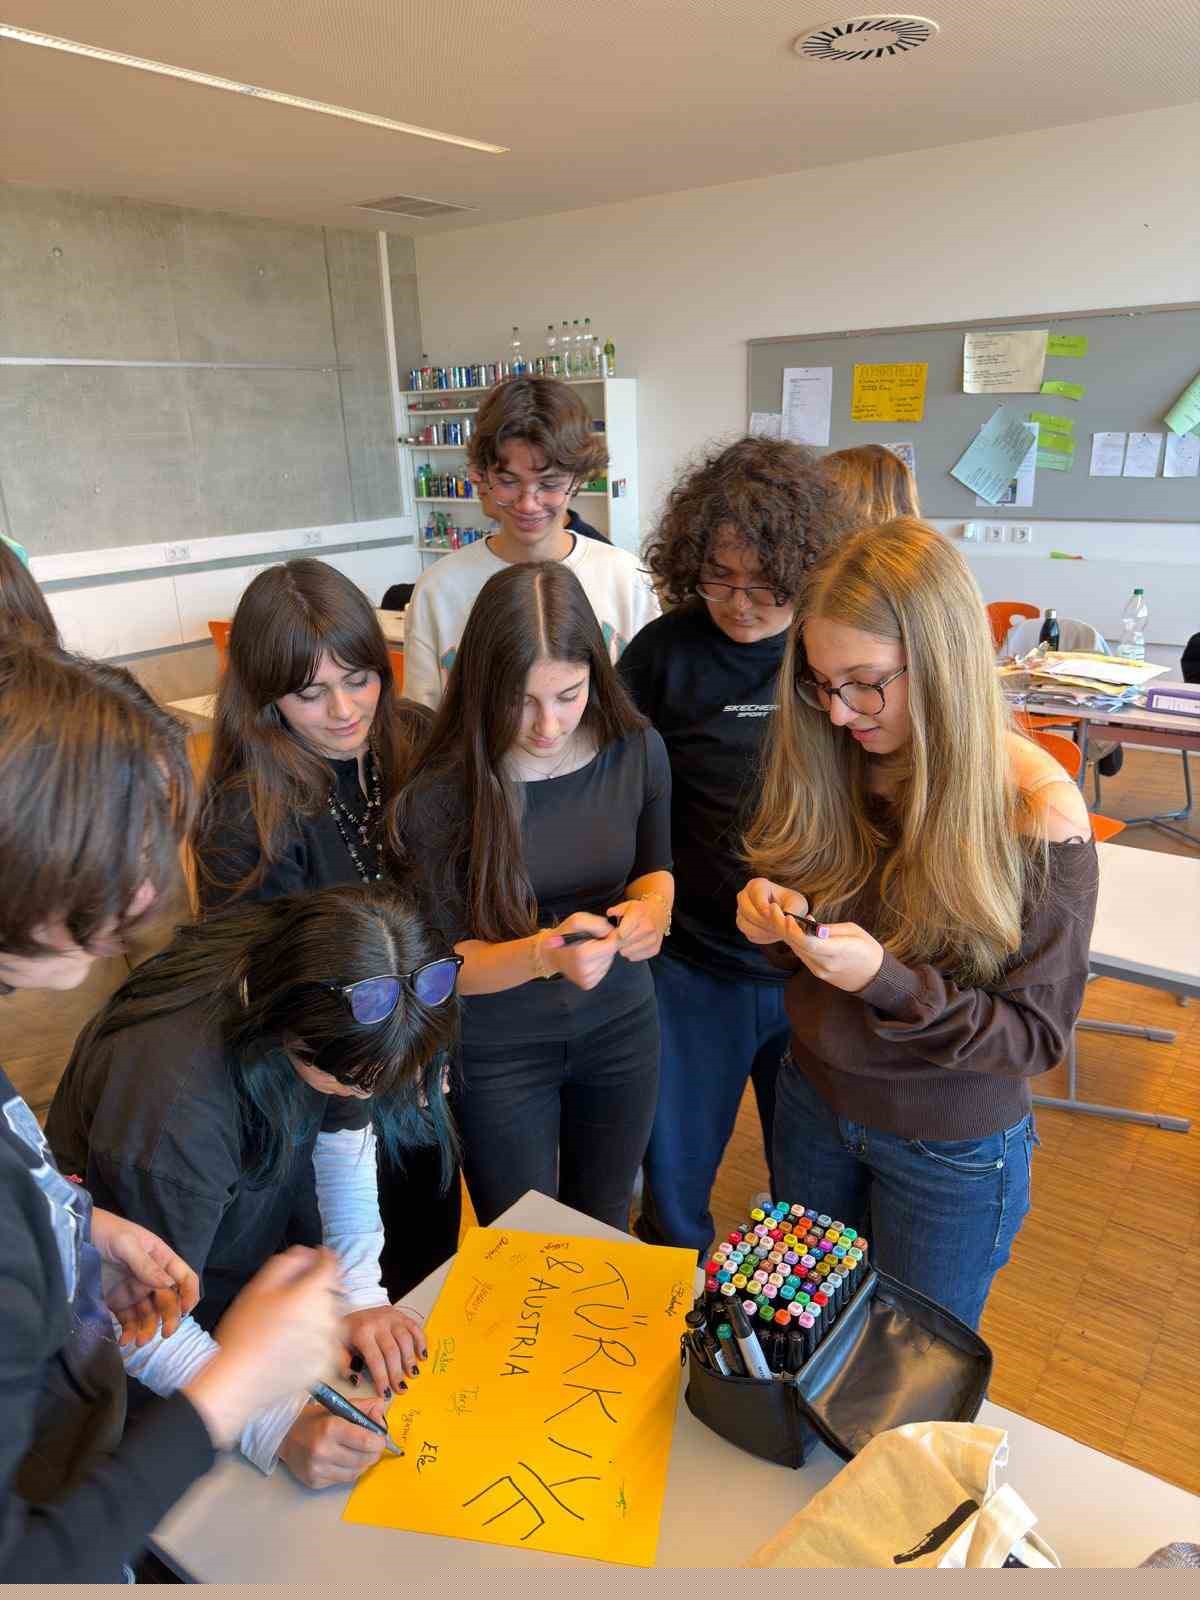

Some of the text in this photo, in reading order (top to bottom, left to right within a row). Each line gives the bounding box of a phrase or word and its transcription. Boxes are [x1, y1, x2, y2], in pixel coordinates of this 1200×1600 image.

[545, 1255, 585, 1275] &
[499, 1276, 561, 1377] AUSTRIA
[416, 1441, 440, 1474] Efe
